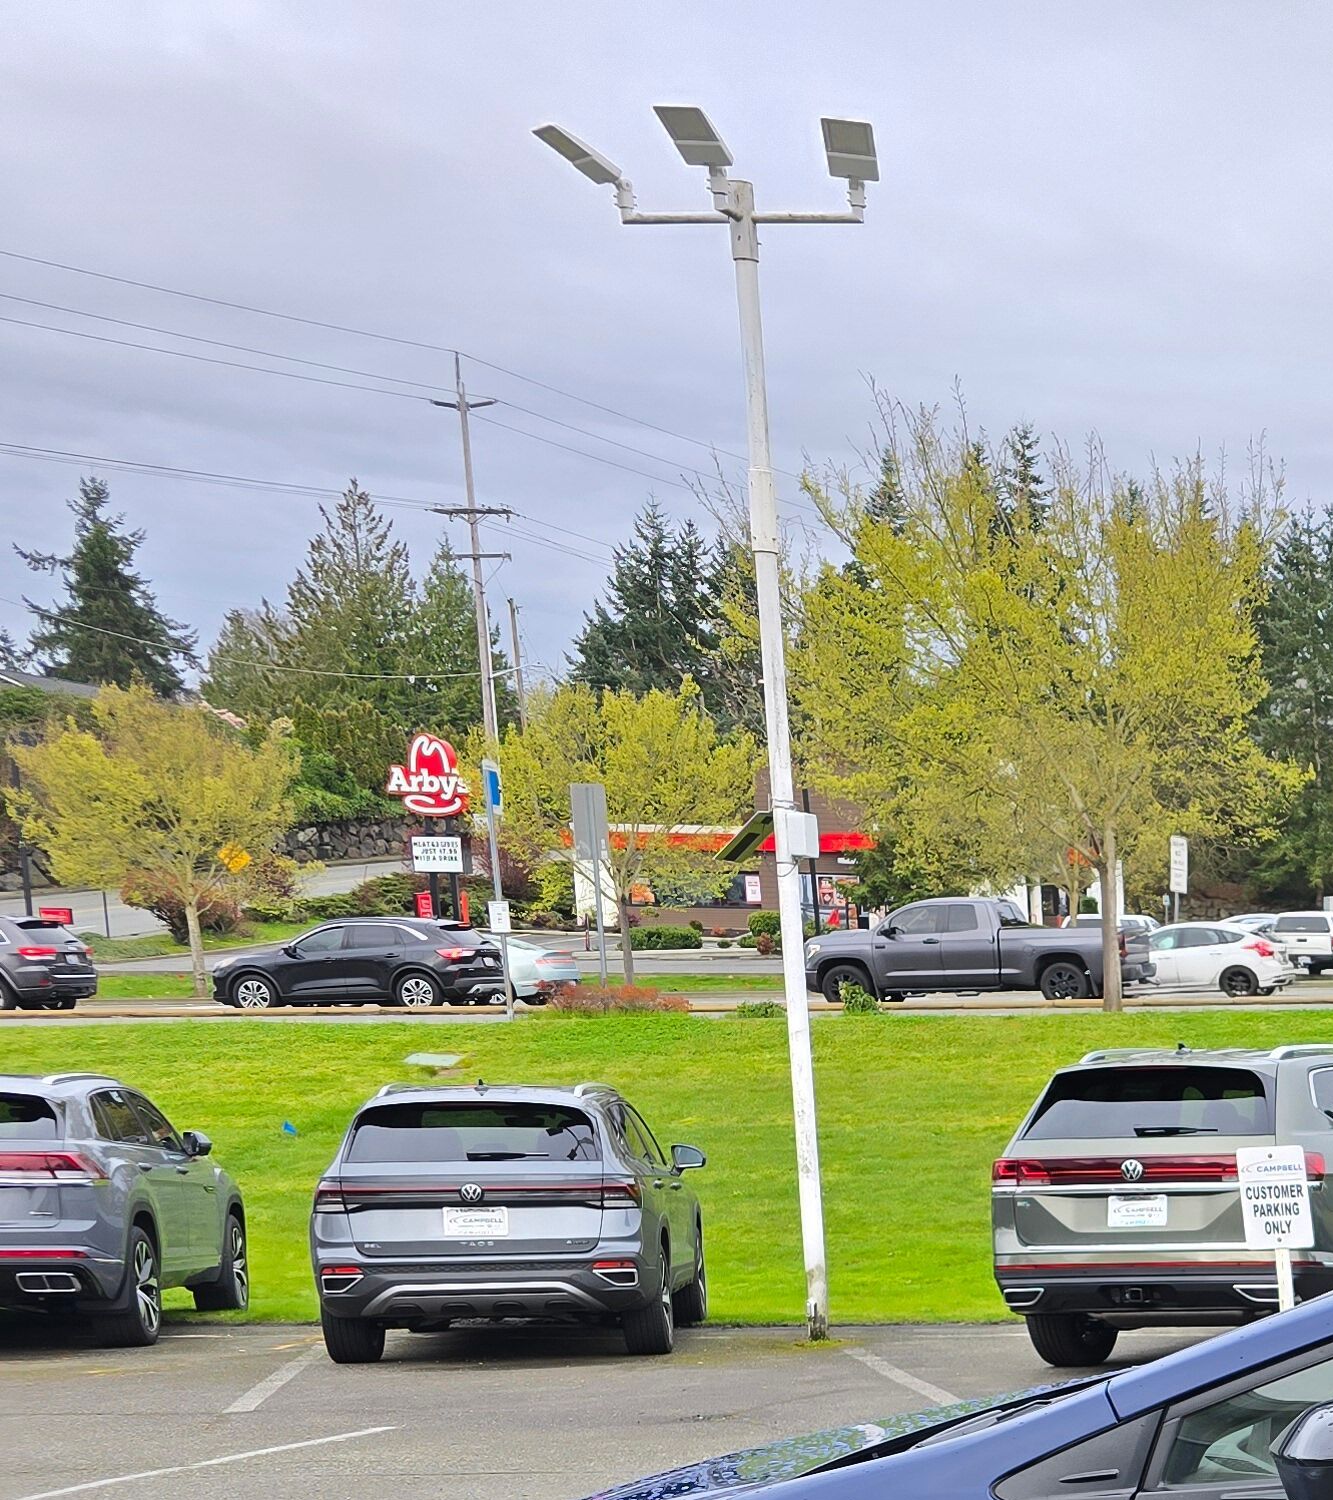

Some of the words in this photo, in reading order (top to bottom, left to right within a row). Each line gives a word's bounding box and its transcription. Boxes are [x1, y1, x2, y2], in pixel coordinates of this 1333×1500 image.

[388, 766, 470, 800] Arby's
[1256, 1164, 1304, 1173] CAMPBELL
[1245, 1184, 1304, 1200] CUSTOMER
[1253, 1202, 1300, 1218] PARKING
[1264, 1220, 1292, 1235] ONLY
